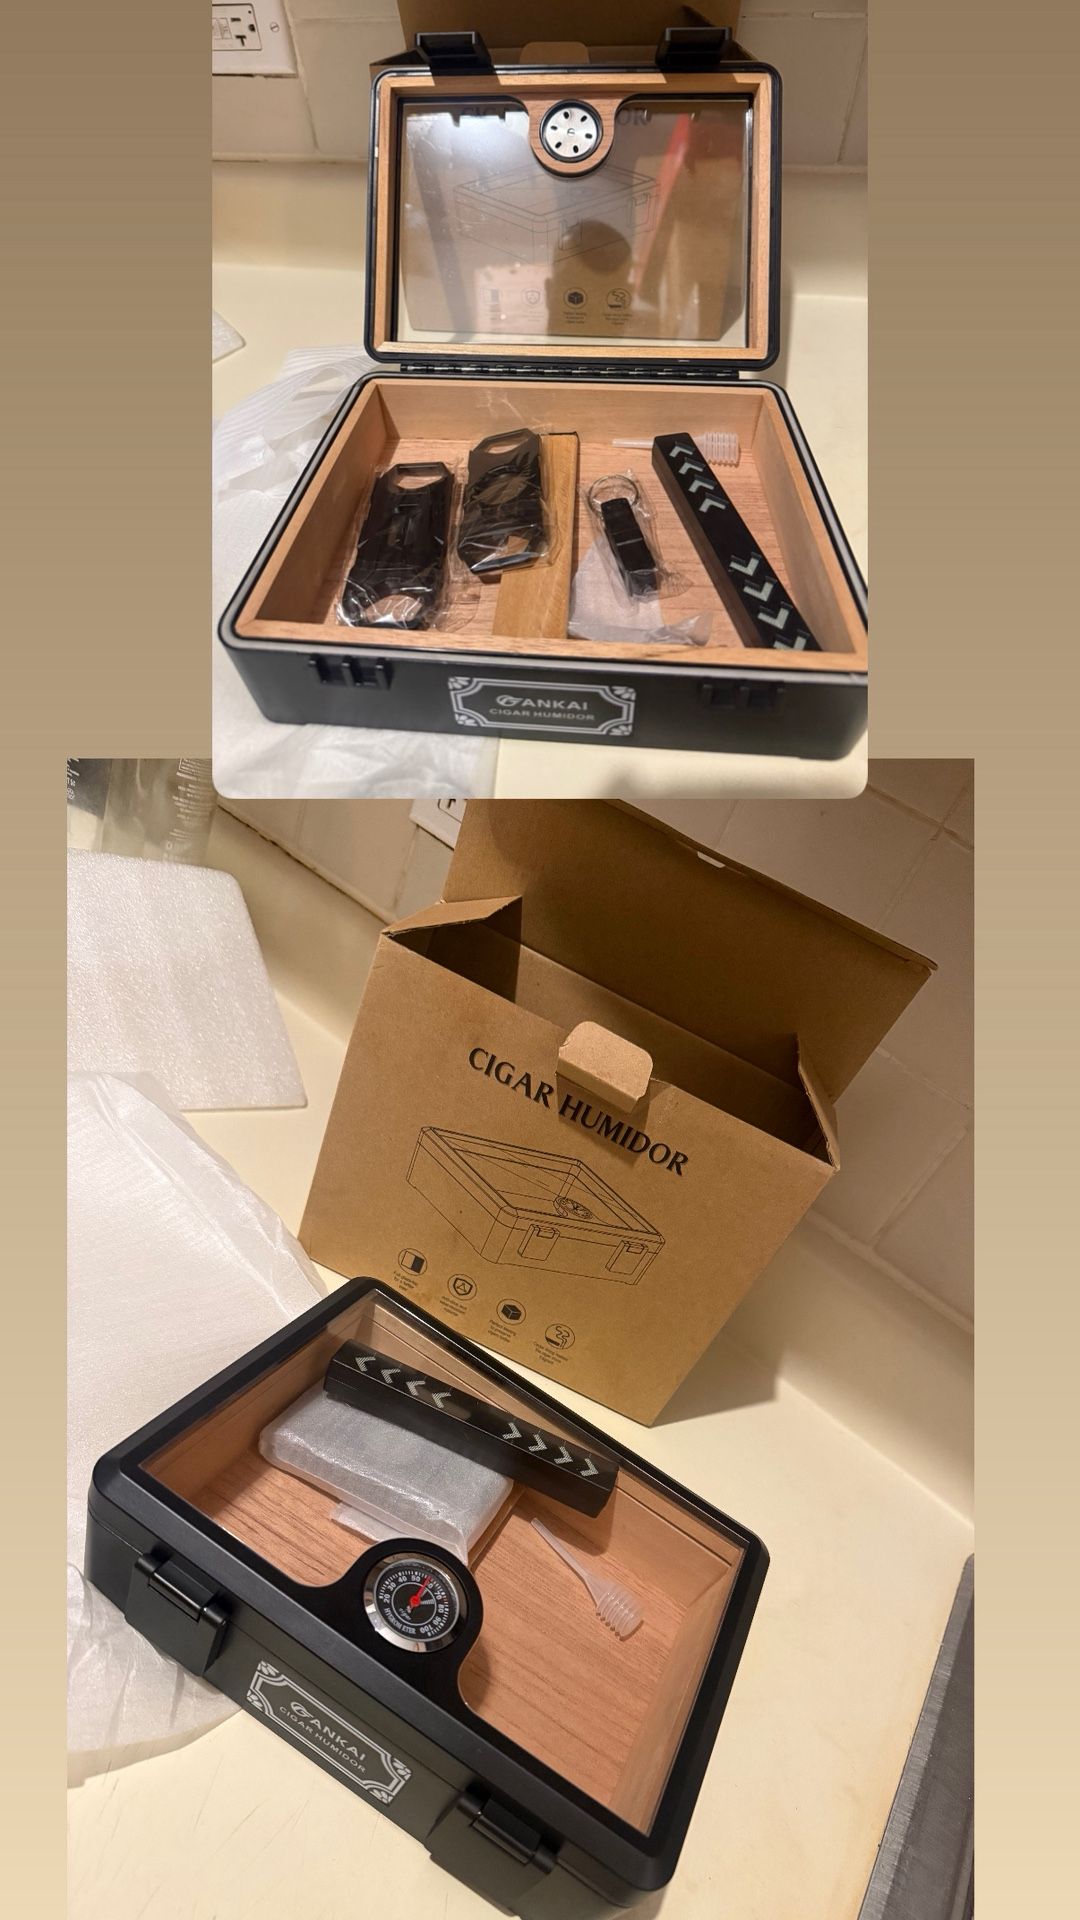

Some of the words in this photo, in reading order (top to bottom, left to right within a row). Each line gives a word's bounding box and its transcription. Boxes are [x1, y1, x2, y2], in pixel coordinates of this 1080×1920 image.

[489, 708, 530, 718] CIGAR
[533, 711, 596, 721] HUMIDOR
[468, 1047, 555, 1109] CIGAR
[558, 1093, 689, 1177] HUMIDOR
[383, 1593, 391, 1604] 20
[434, 1591, 442, 1600] 70
[420, 1624, 433, 1634] 100
[280, 1706, 313, 1734] CIGAR
[314, 1732, 367, 1774] HUMIDOR
